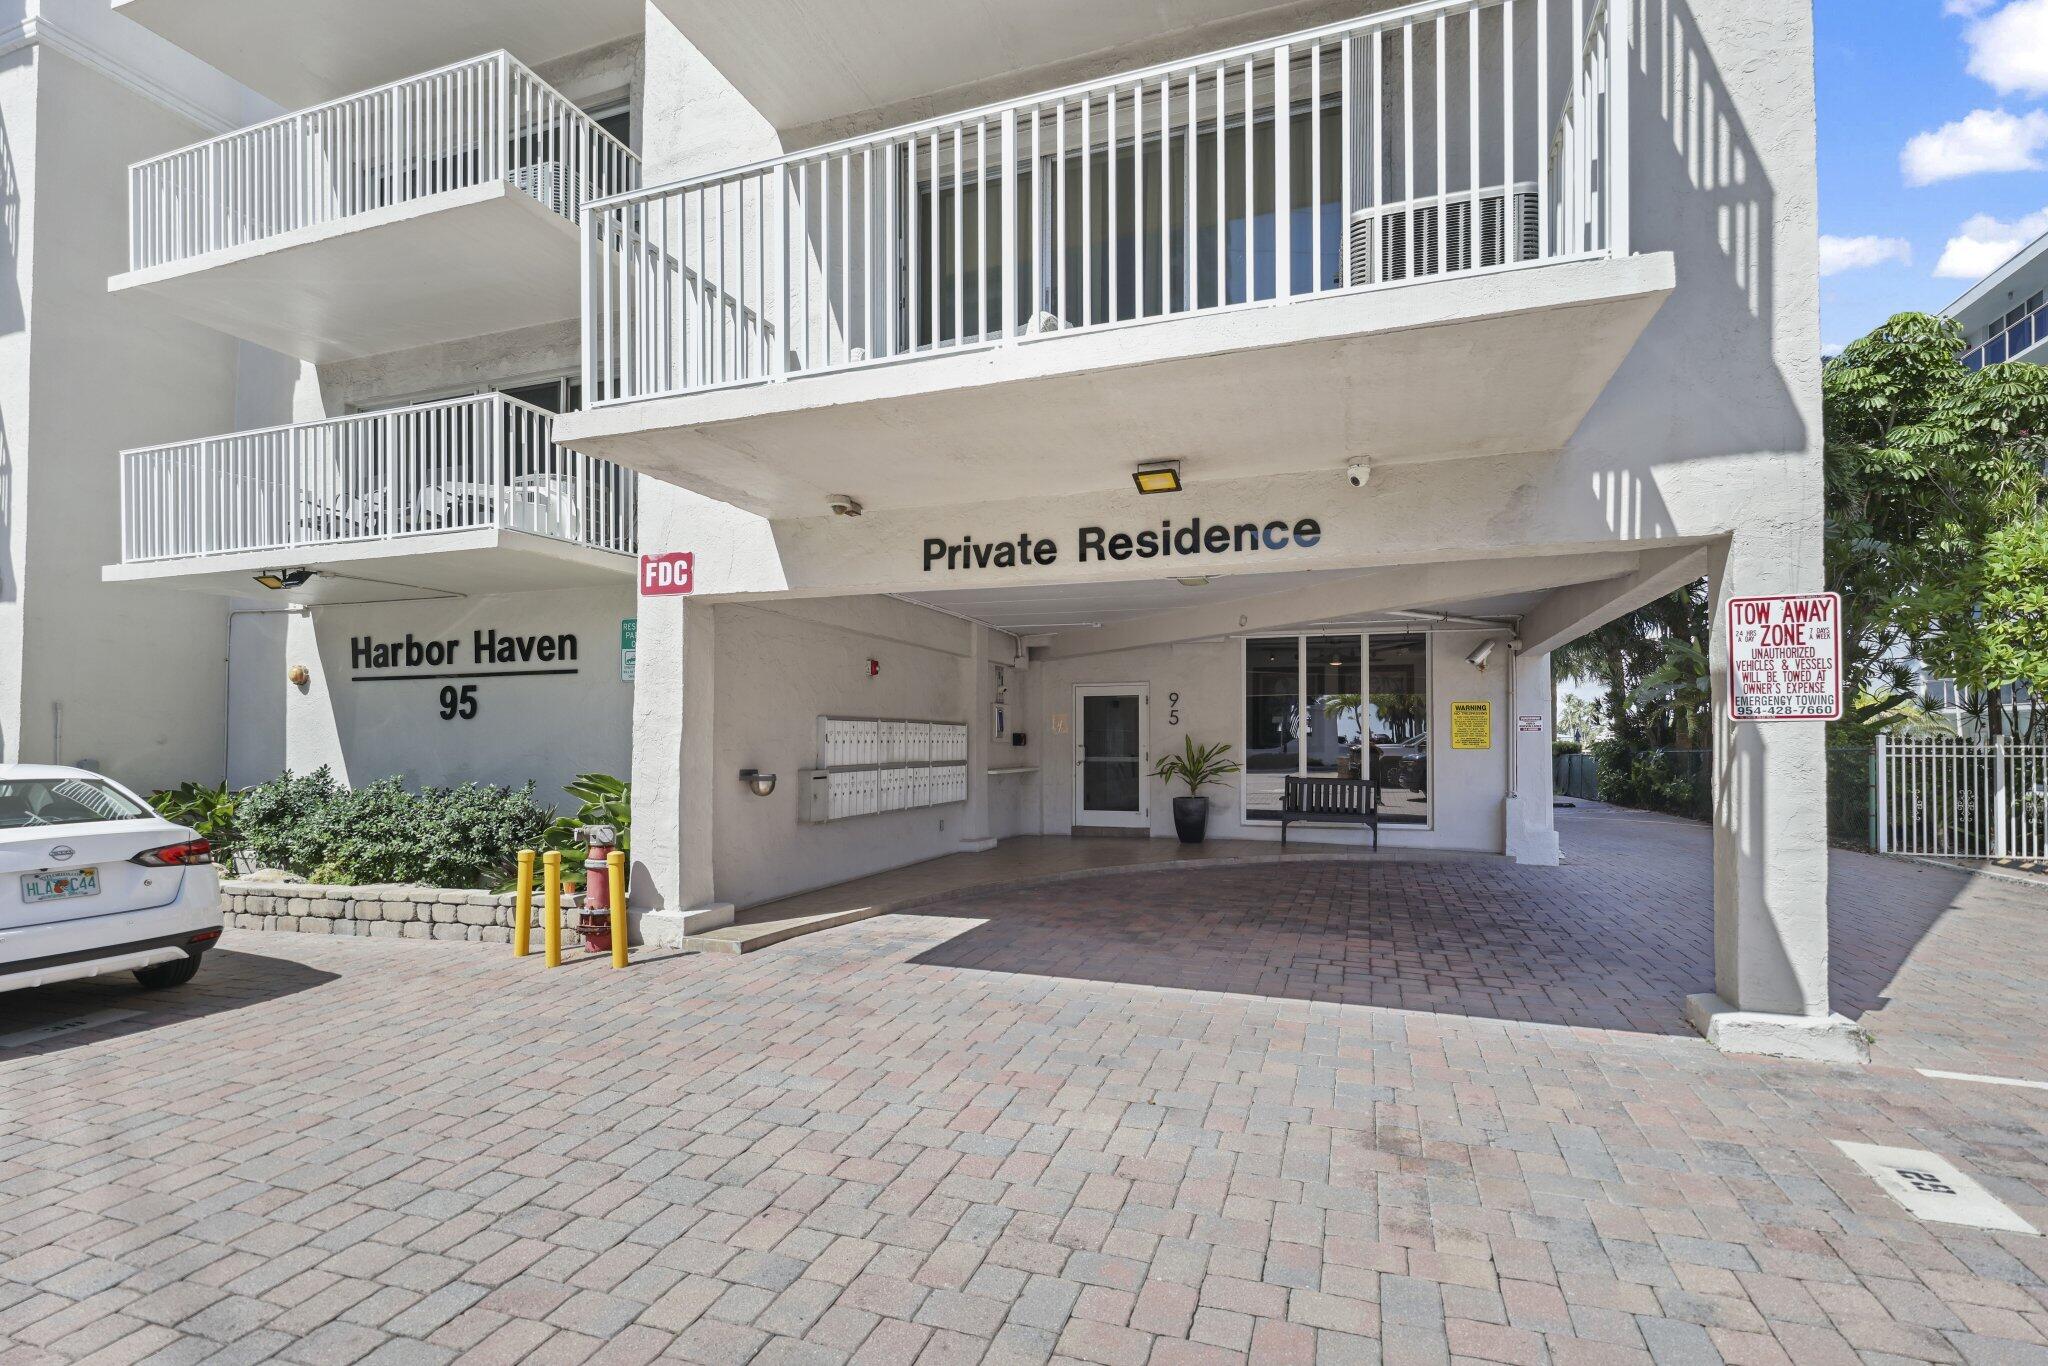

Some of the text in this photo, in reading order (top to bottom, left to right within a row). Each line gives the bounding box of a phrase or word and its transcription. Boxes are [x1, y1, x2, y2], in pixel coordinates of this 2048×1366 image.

[922, 516, 1322, 572] Private Residence
[645, 560, 688, 588] FDC
[1734, 600, 1831, 625] TOW AWAY
[1760, 624, 1806, 646] ZONE
[351, 629, 578, 669] Harbor Haven
[1751, 646, 1816, 660] UNAUTHORIZED
[1736, 658, 1832, 671] VEHICLES & VESSELS
[1742, 670, 1826, 683] WILL BE TOWED AT
[1743, 682, 1825, 694] OWNER'S EXPENSE
[439, 684, 478, 721] 95
[1735, 694, 1834, 706] EMERGENCY TOWING
[1737, 706, 1833, 715] 954-428-7660
[26, 875, 96, 896] HLA C44
